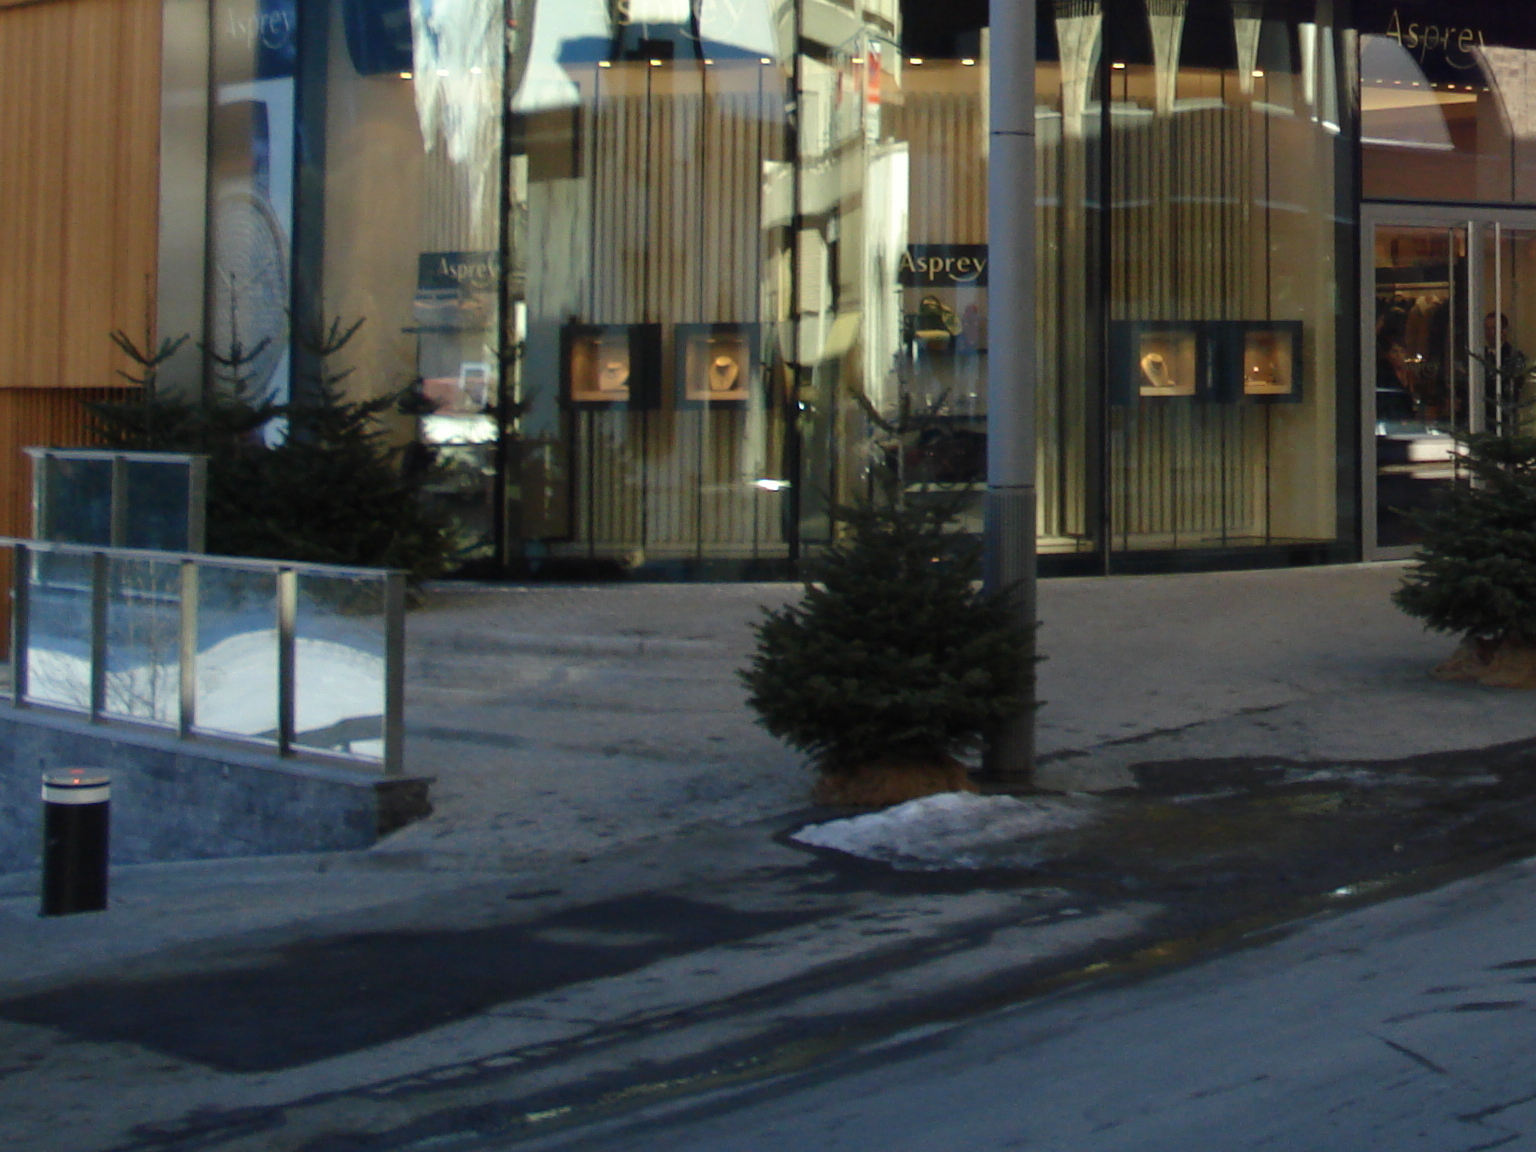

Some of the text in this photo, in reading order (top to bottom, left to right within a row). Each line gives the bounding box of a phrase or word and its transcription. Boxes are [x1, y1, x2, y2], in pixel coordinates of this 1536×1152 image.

[227, 6, 291, 50] Asprey
[1385, 8, 1489, 69] Asprey
[437, 256, 498, 287] Asprey
[899, 249, 987, 282] Asprey
